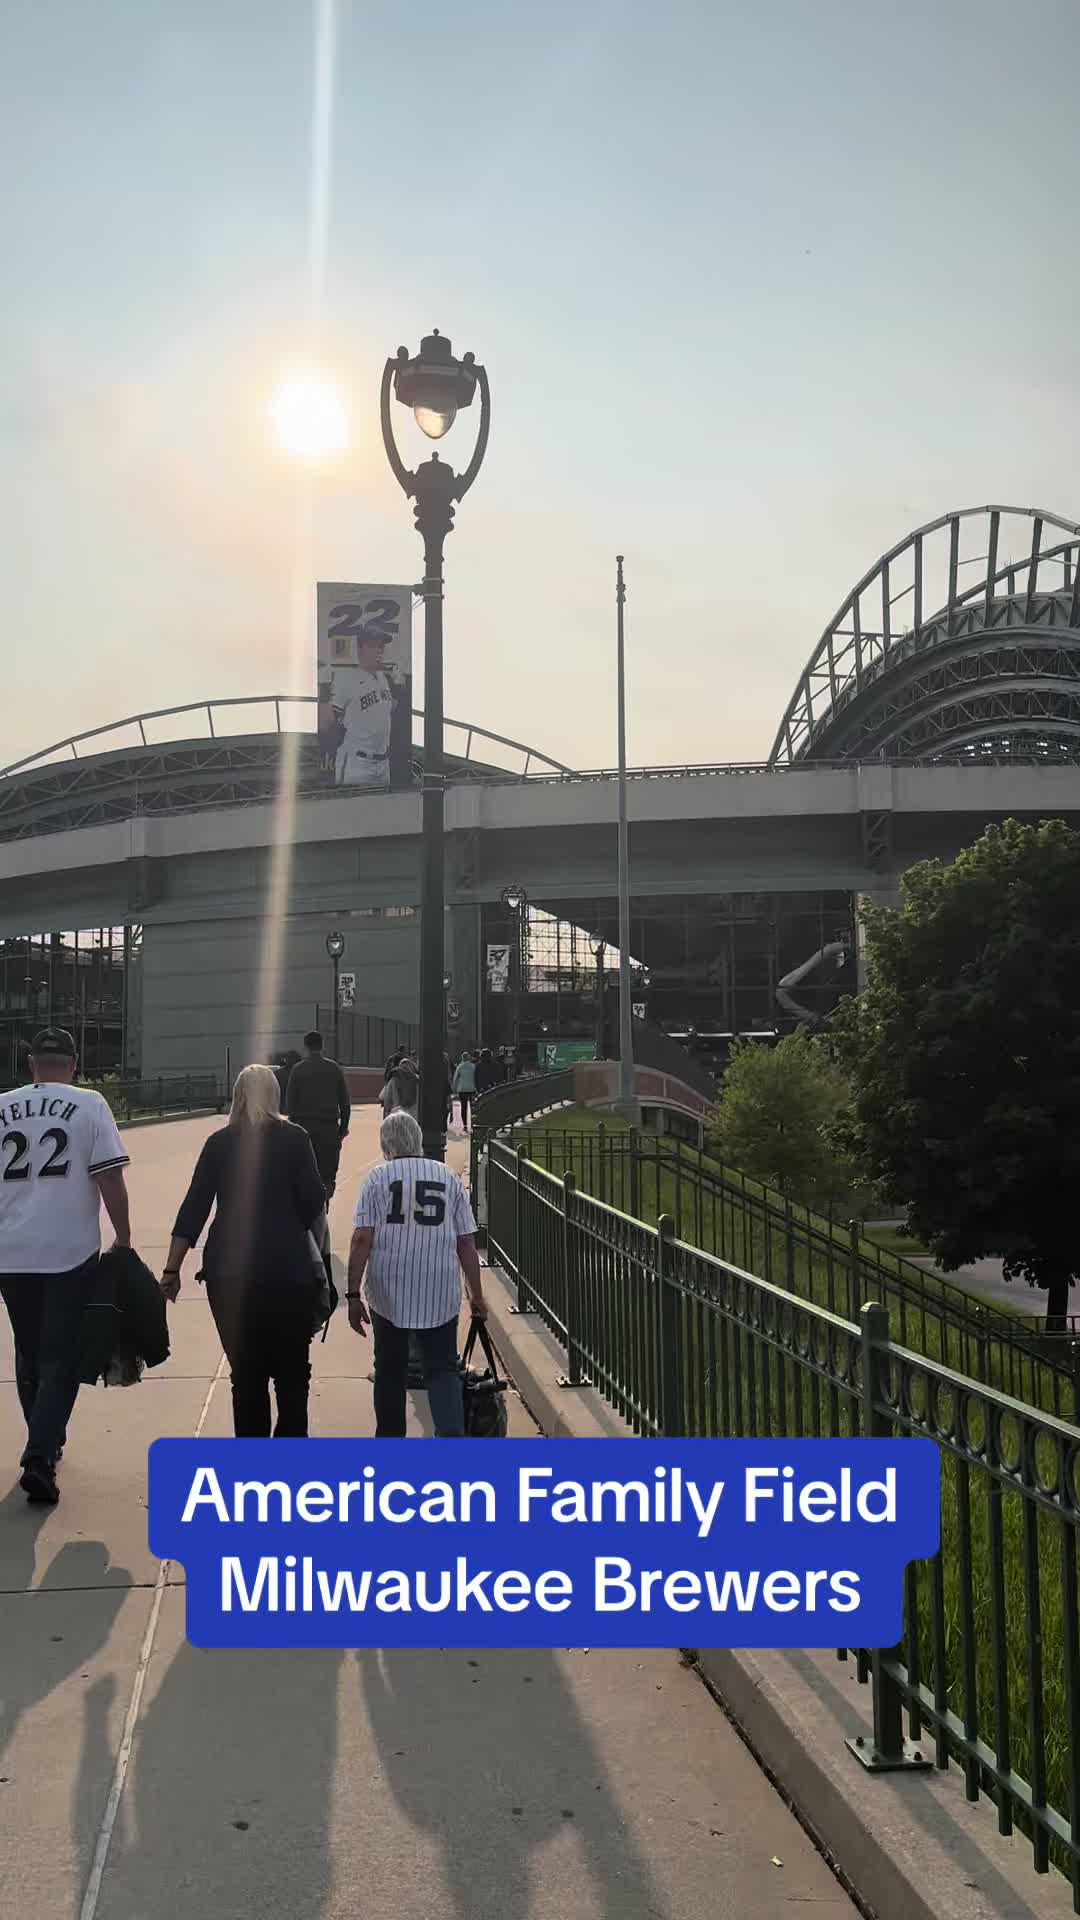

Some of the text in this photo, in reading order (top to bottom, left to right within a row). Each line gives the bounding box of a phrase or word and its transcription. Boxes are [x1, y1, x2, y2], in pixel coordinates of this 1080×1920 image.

[328, 599, 400, 637] 22
[0, 1097, 79, 1127] YELICH
[2, 1127, 70, 1180] 22
[386, 1180, 446, 1226] 15
